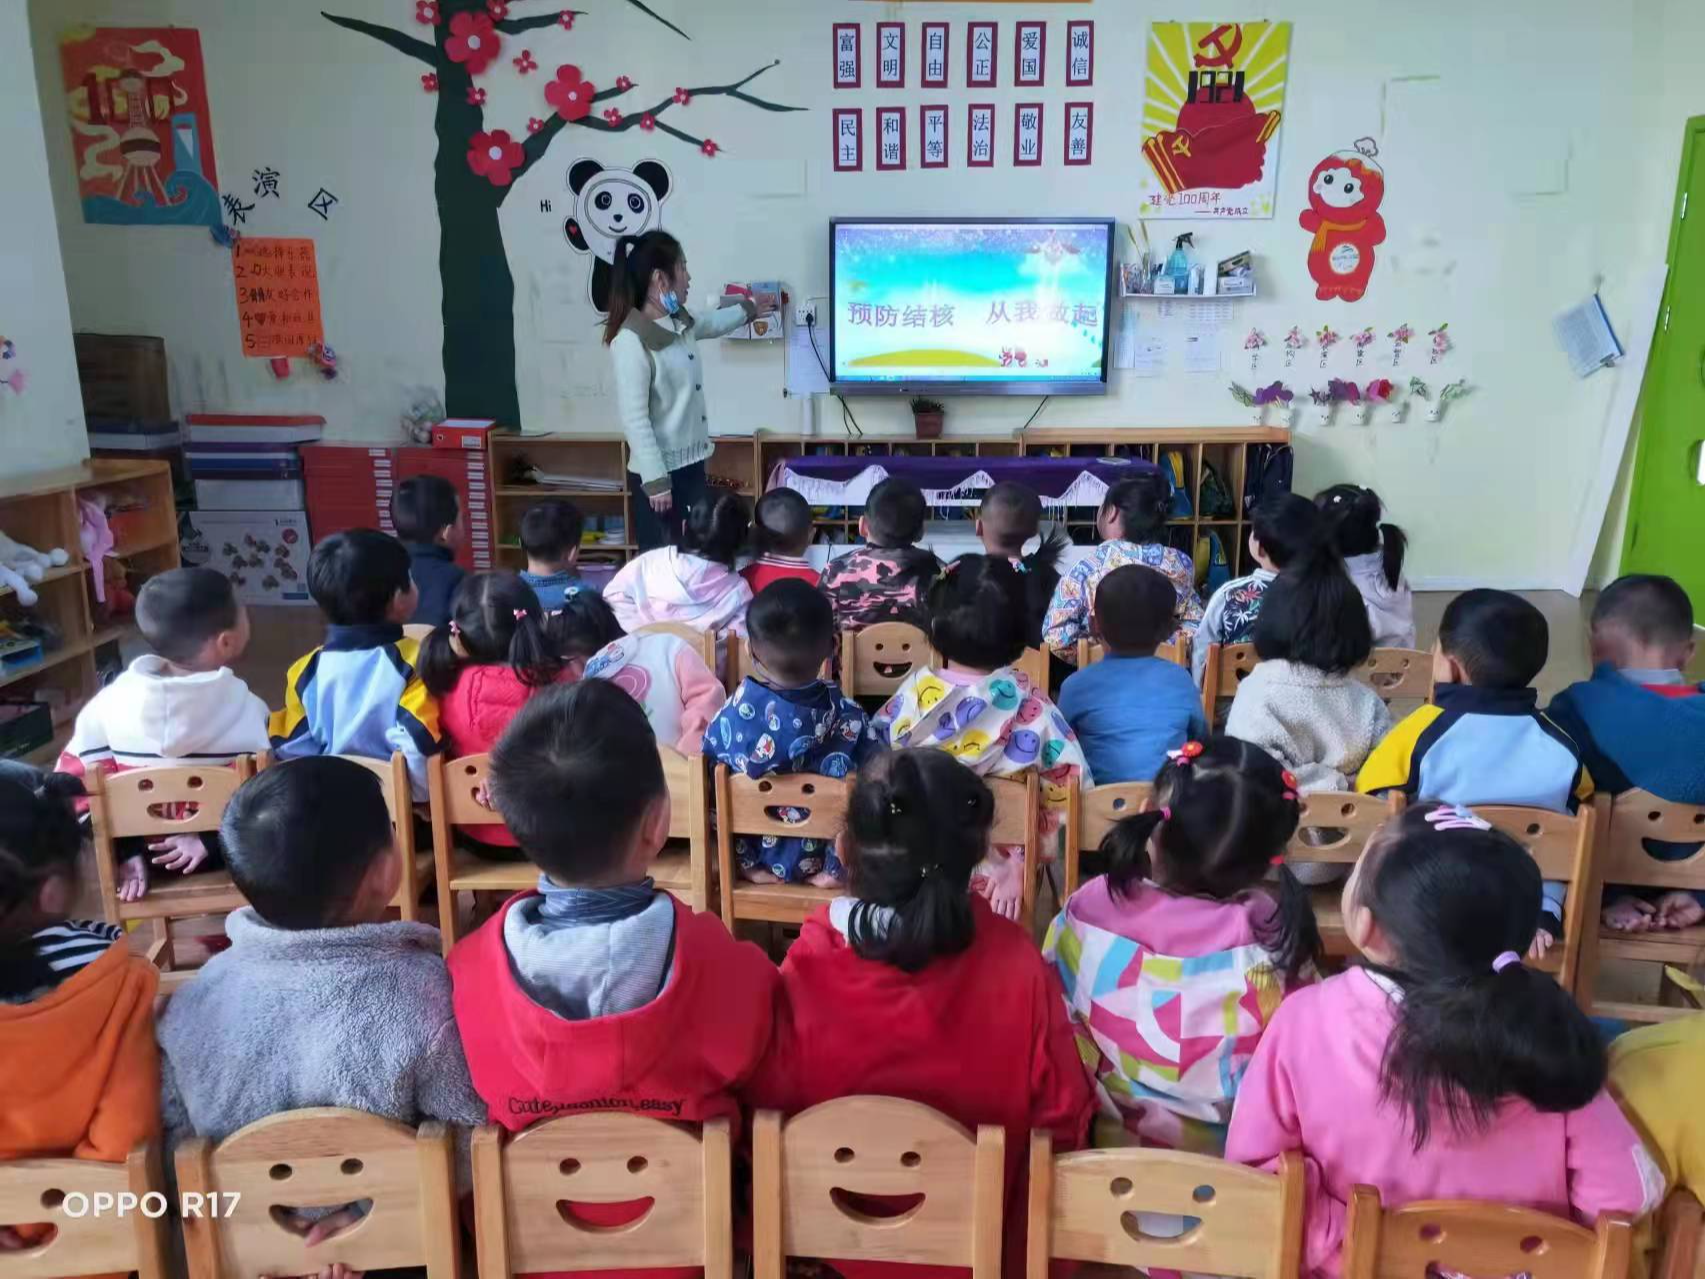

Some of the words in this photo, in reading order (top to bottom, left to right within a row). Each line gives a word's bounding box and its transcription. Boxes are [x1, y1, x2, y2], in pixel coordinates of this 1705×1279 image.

[839, 33, 856, 78] 富强
[882, 32, 899, 76] 文明
[928, 32, 943, 77] 自由
[974, 32, 991, 76] 公正
[1021, 32, 1038, 76] 爱国
[1071, 31, 1089, 76] 诚信
[840, 118, 857, 162] 民主
[883, 118, 899, 160] 和谐
[927, 115, 943, 158] 平等
[973, 114, 989, 157] 法治
[1020, 113, 1037, 156] 敬业
[1070, 112, 1087, 155] 友善
[540, 199, 551, 213] Hi
[848, 302, 955, 328] 预防结核
